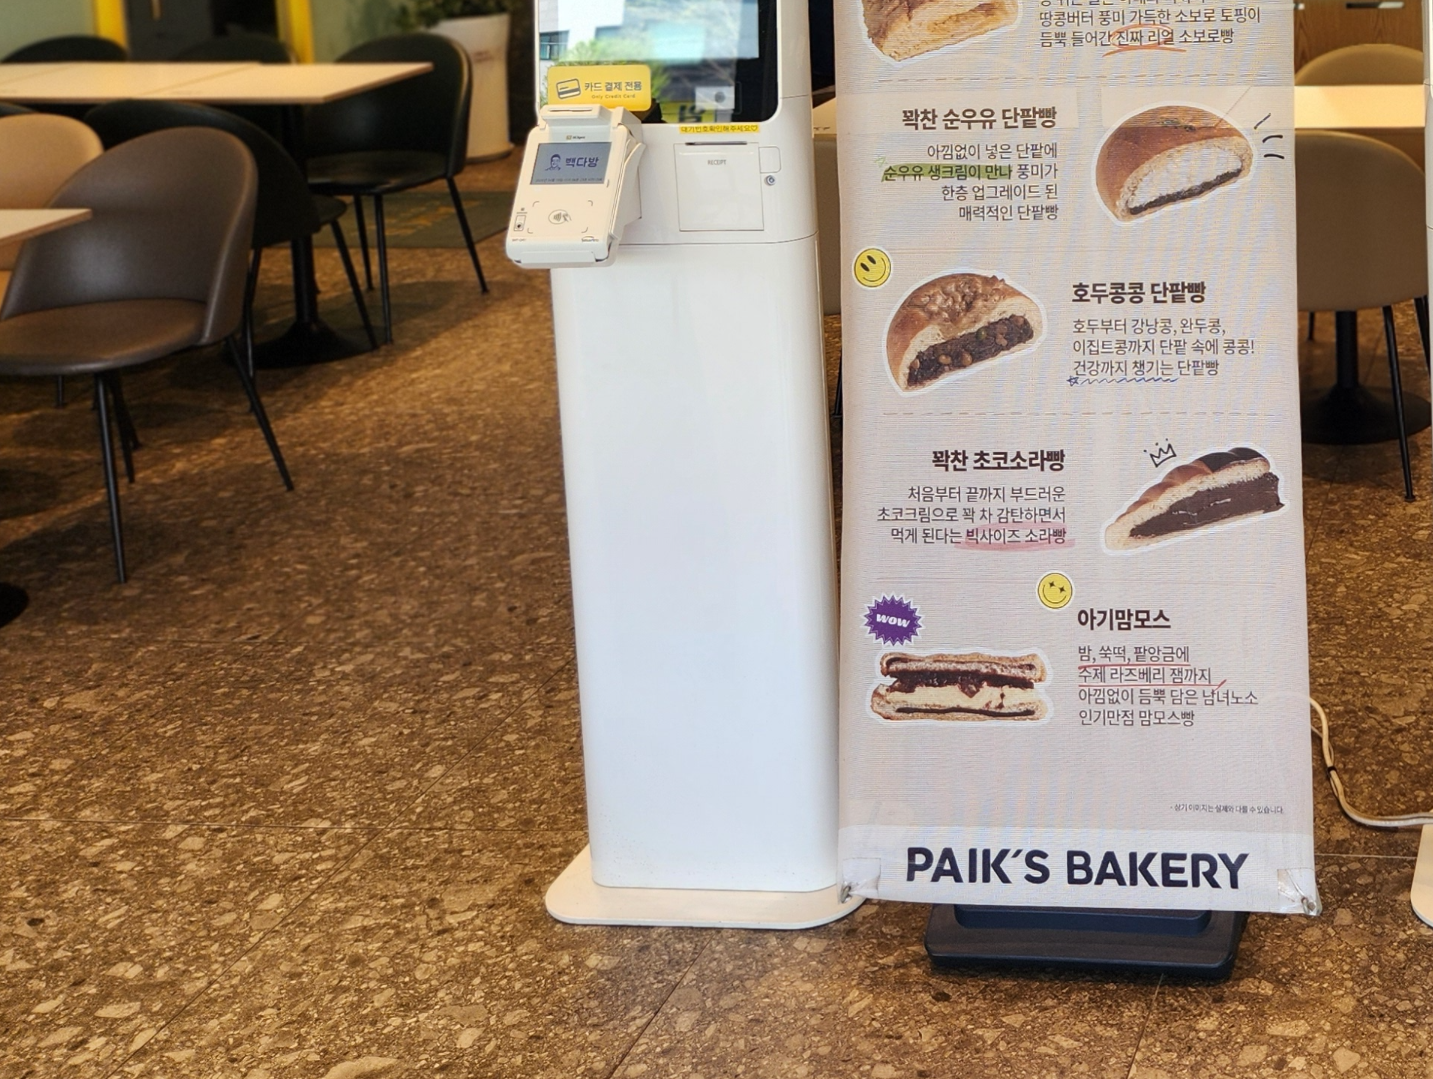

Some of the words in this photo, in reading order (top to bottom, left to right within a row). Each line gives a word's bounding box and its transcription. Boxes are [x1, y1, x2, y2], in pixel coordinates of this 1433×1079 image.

[1039, 9, 1094, 27] 땅콩버터
[1098, 8, 1126, 27] 풍미
[1129, 7, 1171, 26] 가득한
[1174, 7, 1216, 25] 소보로
[1220, 6, 1261, 24] 토핑이
[1039, 29, 1067, 48] 듬뿍
[1070, 28, 1112, 47] 들어간
[1115, 28, 1144, 46] 진짜
[1147, 28, 1175, 46] 리얼
[1178, 27, 1235, 45] 소보로빵
[584, 81, 603, 92] 카드
[604, 81, 622, 91] 결제
[624, 80, 642, 91] 전용
[901, 108, 938, 130] 꽉찬
[942, 107, 997, 129] 순우유
[1001, 105, 1058, 129] 단팥빵
[926, 142, 982, 161] 아낌없이
[985, 142, 1013, 161] 넣은
[1015, 141, 1058, 160] 단팥에
[884, 163, 924, 182] 순우유
[927, 163, 982, 181] 생크림이
[984, 163, 1013, 181] 만나
[1016, 162, 1058, 181] 풍미가
[941, 184, 968, 202] 한층
[972, 184, 1041, 202] 업그레이드
[1044, 183, 1059, 202] 된
[958, 204, 1014, 222] 매력적인
[1016, 203, 1059, 221] 단팥빵
[1071, 282, 1146, 305] 호두콩콩
[1149, 281, 1206, 304] 단팥빵
[1072, 318, 1127, 336] 호두부터
[1131, 318, 1177, 337] 강낭콩,
[1180, 318, 1226, 337] 완두콩,
[1072, 339, 1156, 356] 이집트콩까지
[1159, 338, 1187, 356] 단팥
[1190, 338, 1219, 356] 속에
[1222, 338, 1255, 356] 콩콩!
[1072, 359, 1128, 377] 건강까지
[1131, 359, 1174, 377] 챙기는
[1177, 359, 1219, 377] 단팥빵
[931, 450, 968, 472] 꽉찬
[973, 449, 1066, 472] 초코소라빵
[908, 486, 962, 503] 처음부터
[965, 486, 1006, 503] 끝까지
[1009, 486, 1066, 503] 부드러운
[877, 507, 959, 524] 초코크림으로
[962, 507, 976, 523] 꽉
[979, 507, 994, 523] 차
[997, 507, 1066, 524] 감탄하면서
[890, 527, 918, 545] 먹게
[921, 527, 963, 545] 된다는
[965, 527, 1021, 545] 빅사이즈
[1024, 527, 1067, 545] 소라빵
[1077, 608, 1171, 631] 아기맘모스
[1099, 646, 1131, 665] 쑥떡,
[1133, 646, 1190, 664] 팥앙금에
[1078, 667, 1107, 685] 수제
[1110, 667, 1166, 684] 라즈베리
[1169, 667, 1212, 685] 잼까지
[1078, 688, 1134, 706] 아낌없이
[1138, 688, 1166, 706] 듬뿍
[1170, 688, 1199, 706] 담은
[1202, 688, 1259, 706] 남녀노소
[1078, 709, 1135, 727] 인기만점
[1138, 709, 1195, 727] 맘모스빵
[906, 846, 1050, 884] PAIK'S
[1066, 849, 1249, 890] BAKERY
